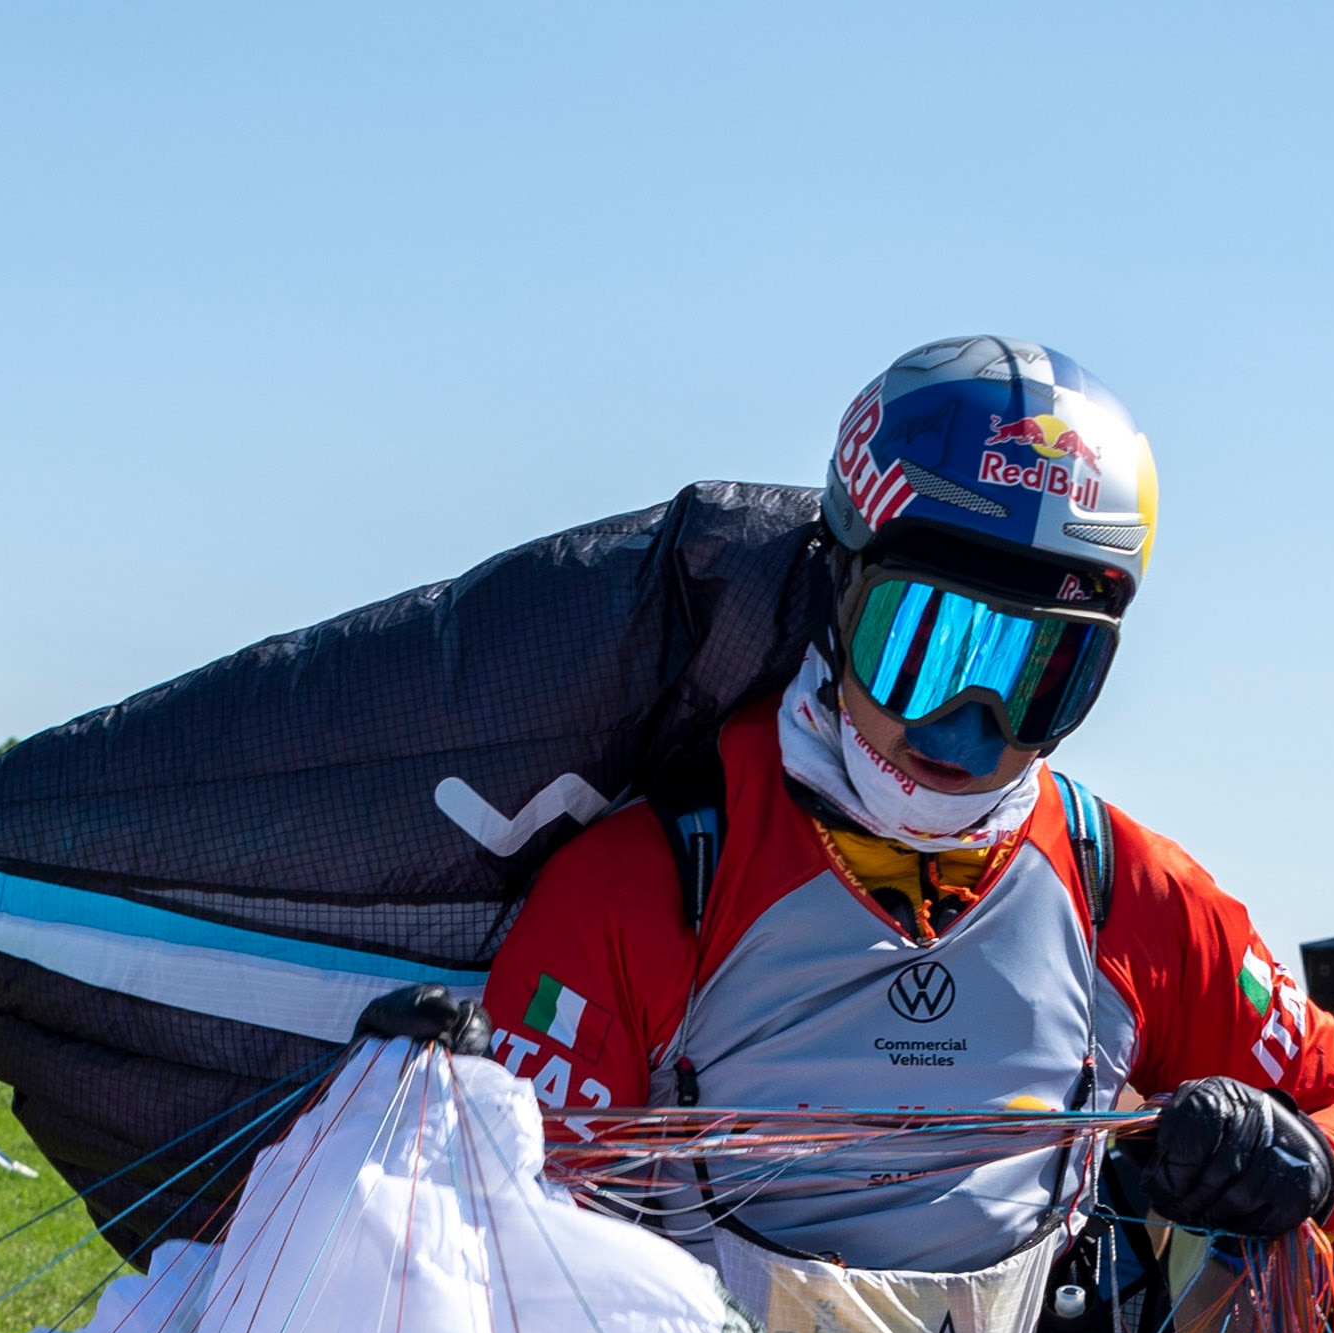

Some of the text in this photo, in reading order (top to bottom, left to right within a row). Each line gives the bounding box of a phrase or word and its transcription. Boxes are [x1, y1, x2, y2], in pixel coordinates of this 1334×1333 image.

[978, 451, 1100, 511] Red Bull
[874, 1038, 967, 1051] Commercial
[889, 1054, 954, 1067] Vehicles
